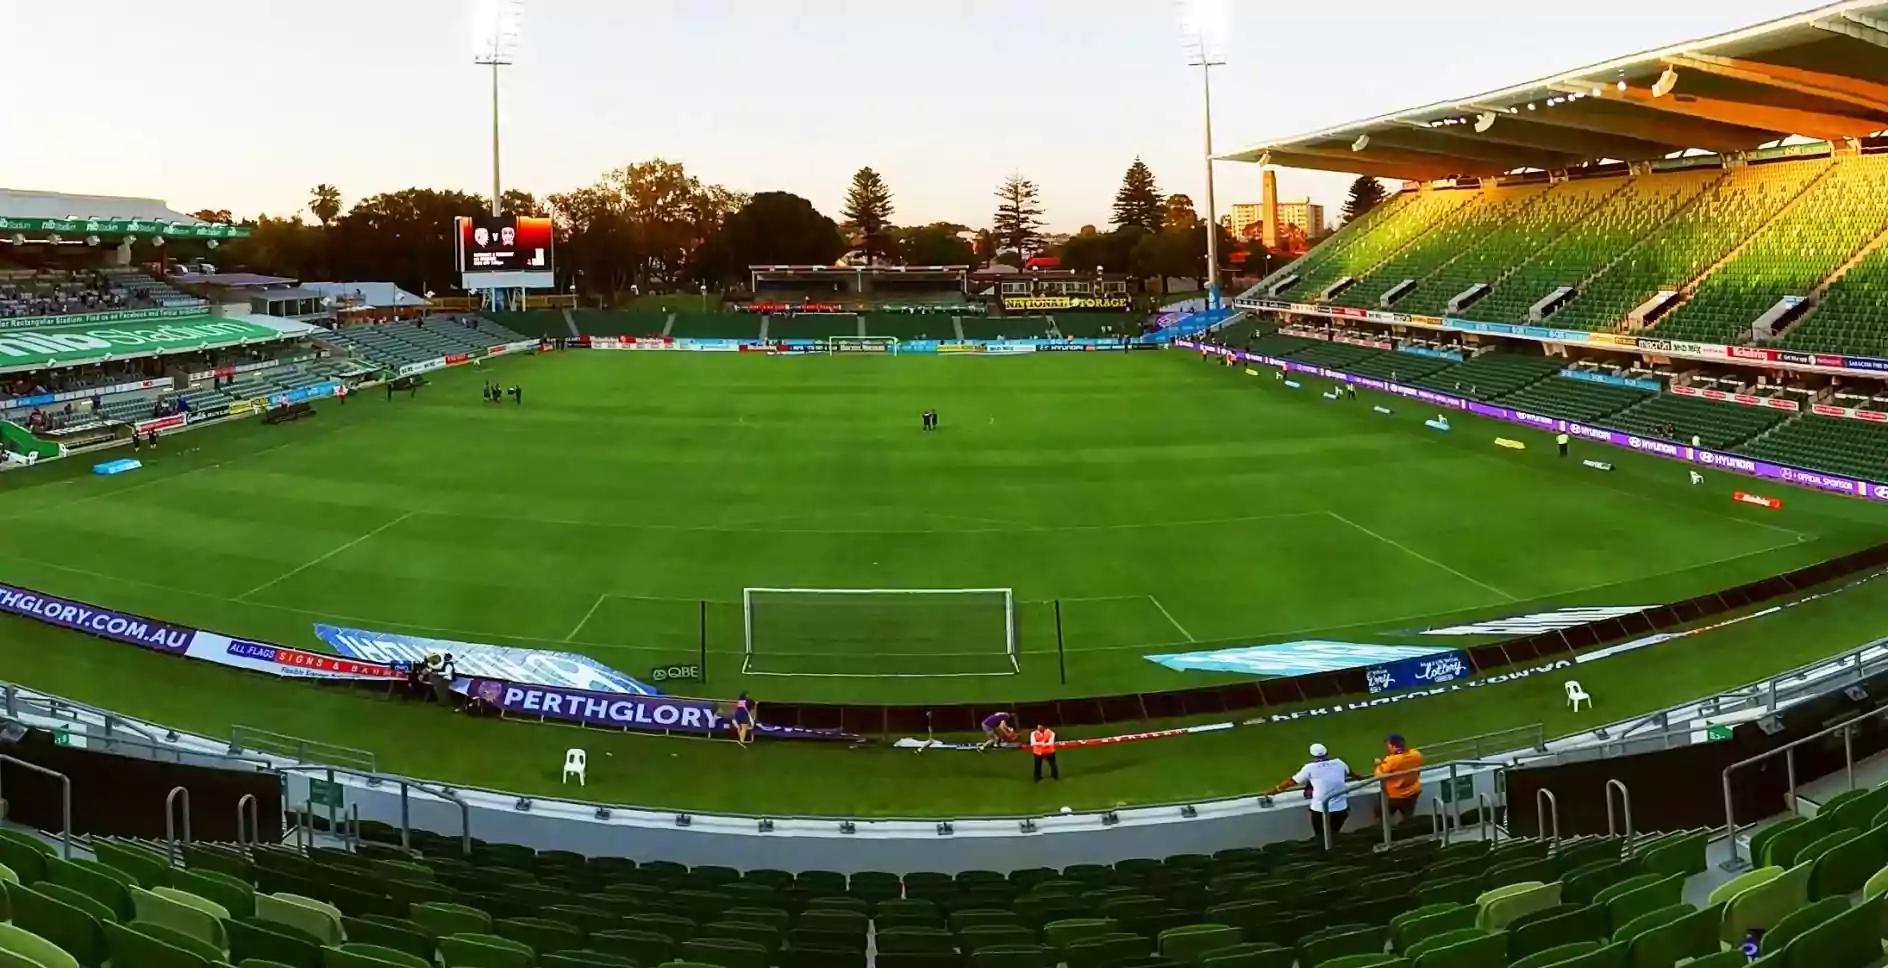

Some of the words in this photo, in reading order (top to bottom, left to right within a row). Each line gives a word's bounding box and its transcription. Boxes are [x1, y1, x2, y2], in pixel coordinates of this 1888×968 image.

[1070, 298, 1127, 308] STORAGE
[11, 317, 55, 328] Rectangular
[56, 315, 82, 325] Stadium
[119, 310, 147, 320] Facebook
[87, 321, 255, 346] Stadium
[1642, 440, 1677, 455] HYUNDAI
[1715, 454, 1754, 471] HYUNDAI
[1798, 473, 1822, 485] OFFICIAL
[1822, 477, 1853, 490] SPONSOR
[230, 643, 245, 654] ALL
[249, 646, 274, 659] FLAGS
[279, 652, 322, 667] SIGNS
[333, 662, 339, 670] &
[668, 666, 698, 678] QBE
